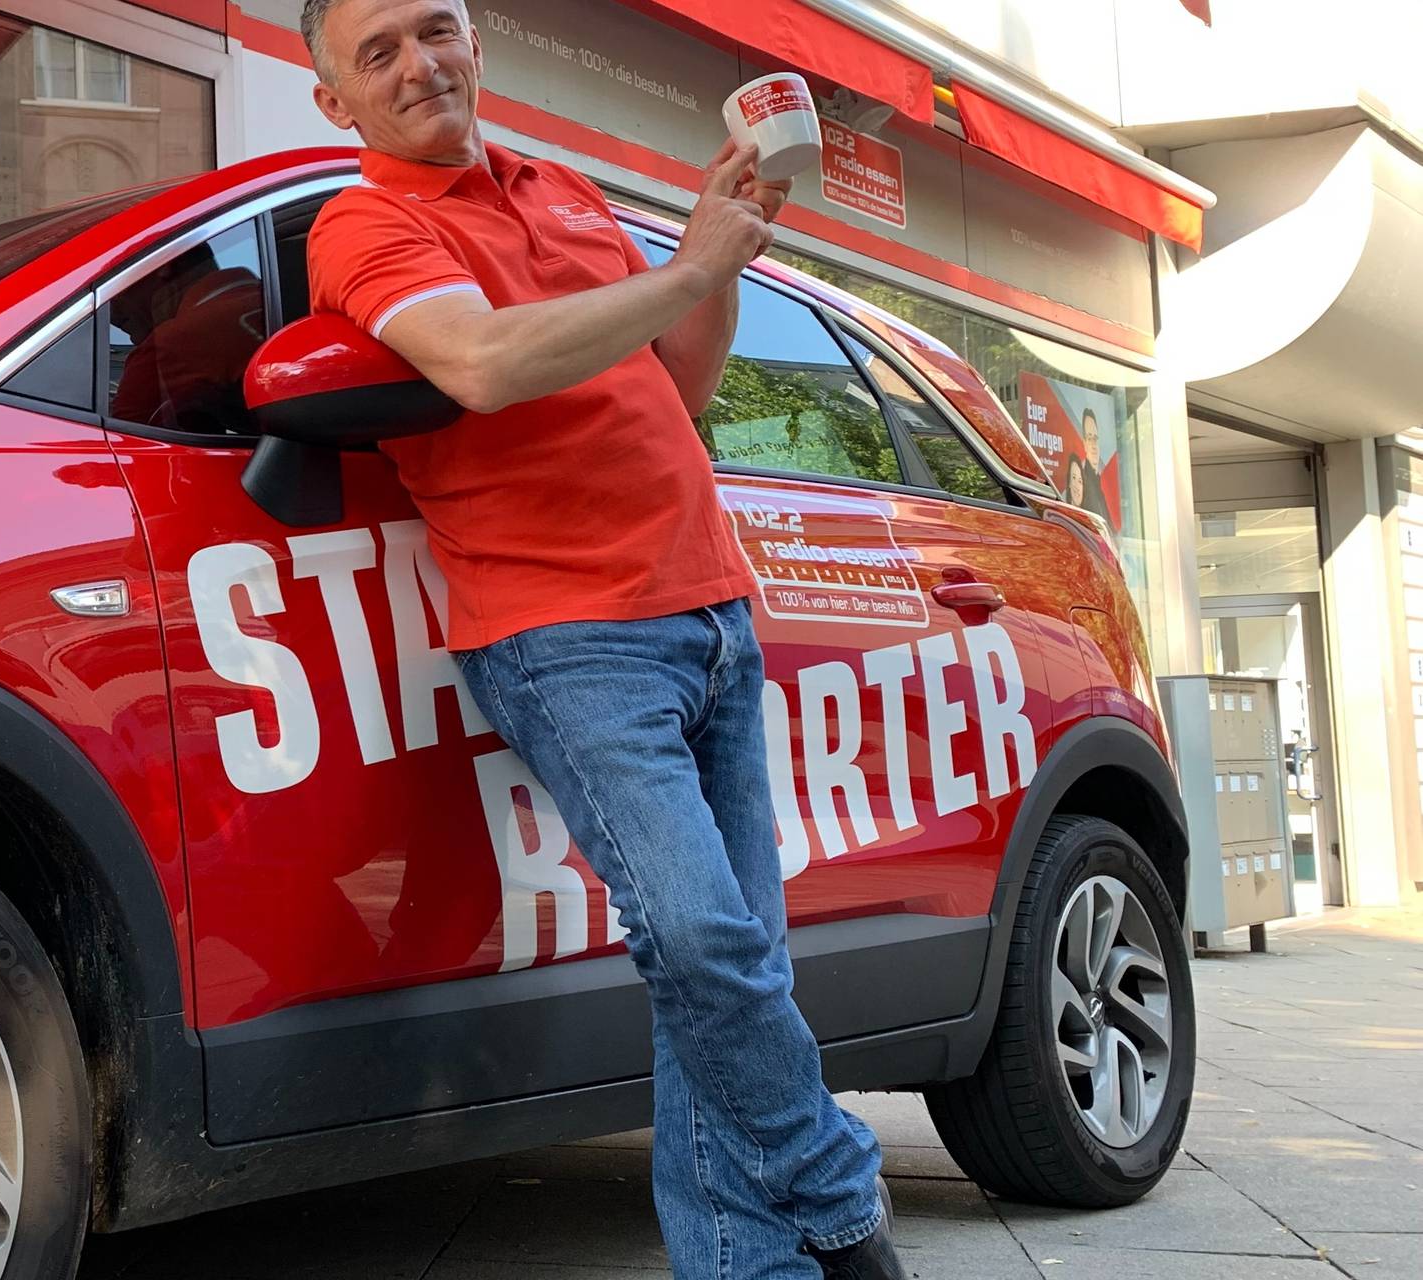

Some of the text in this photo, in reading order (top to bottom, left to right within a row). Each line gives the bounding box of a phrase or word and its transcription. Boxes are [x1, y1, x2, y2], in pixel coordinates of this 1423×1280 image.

[484, 9, 701, 113] 100% von hier. 100% die beste Musik.
[741, 85, 773, 104] 102.2
[749, 92, 782, 109] radio
[823, 124, 856, 153] 102.2
[834, 154, 899, 190] radio essen
[1026, 396, 1047, 423] Euer
[1029, 422, 1063, 456] Morgen
[735, 501, 804, 533] 102.2
[760, 537, 899, 569] radio essen
[776, 591, 918, 616] 100% von hier. Der beste Mix.
[187, 518, 495, 794] STA
[473, 622, 1038, 973] RRTER
